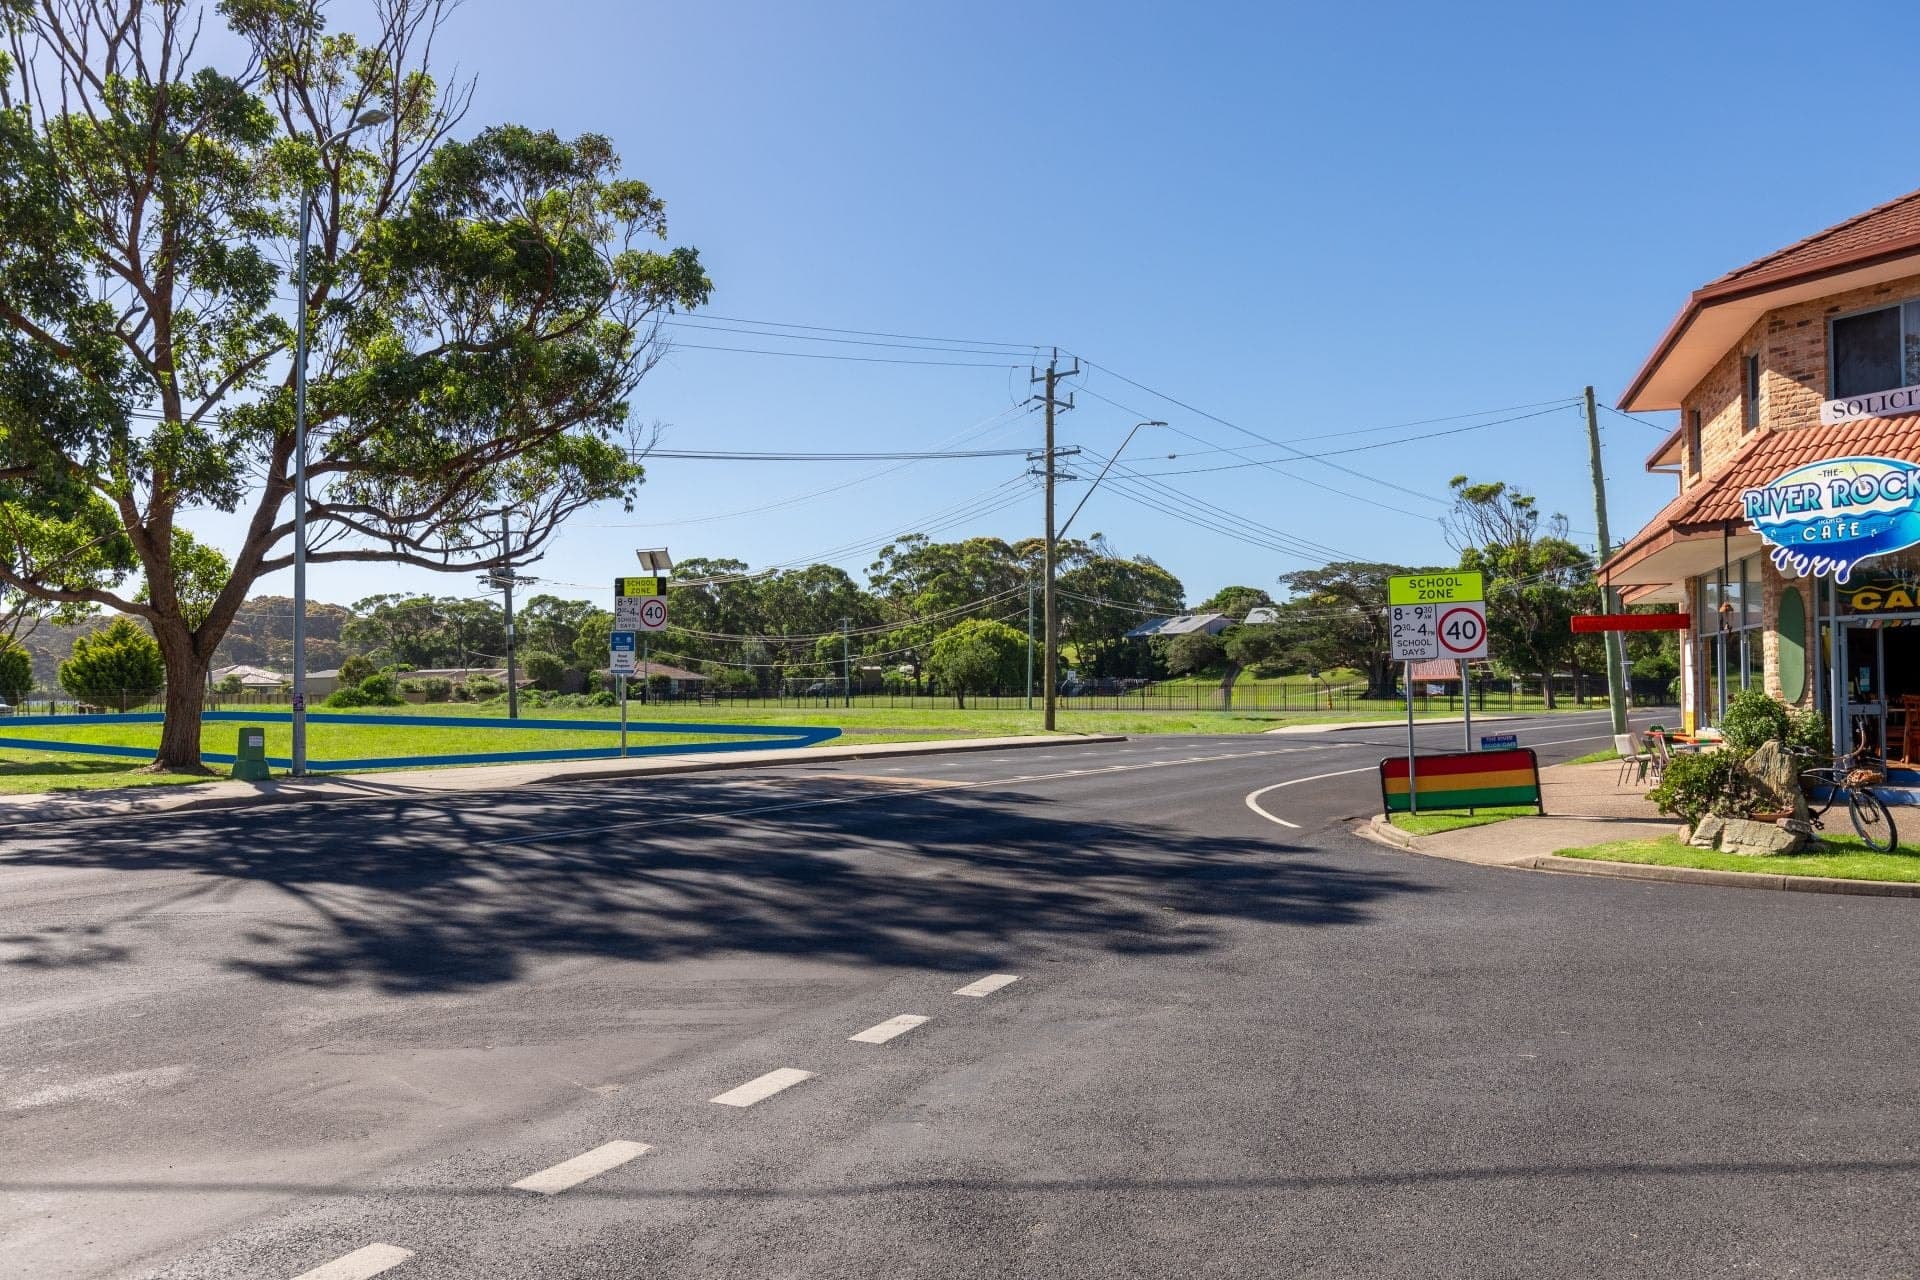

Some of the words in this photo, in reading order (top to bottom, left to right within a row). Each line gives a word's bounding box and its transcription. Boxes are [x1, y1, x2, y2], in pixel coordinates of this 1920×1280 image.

[1832, 389, 1920, 419] SOLICI
[1743, 482, 1823, 520] RIVER
[1828, 470, 1920, 508] ROCK
[1803, 522, 1860, 541] CAFE
[1409, 577, 1463, 589] SCHOOL
[1418, 588, 1454, 600] ZONE
[1851, 588, 1920, 611] CA
[645, 606, 663, 619] 40
[1446, 620, 1477, 640] 40
[1397, 639, 1433, 648] SCHOOL
[1402, 648, 1426, 656] DAYS
